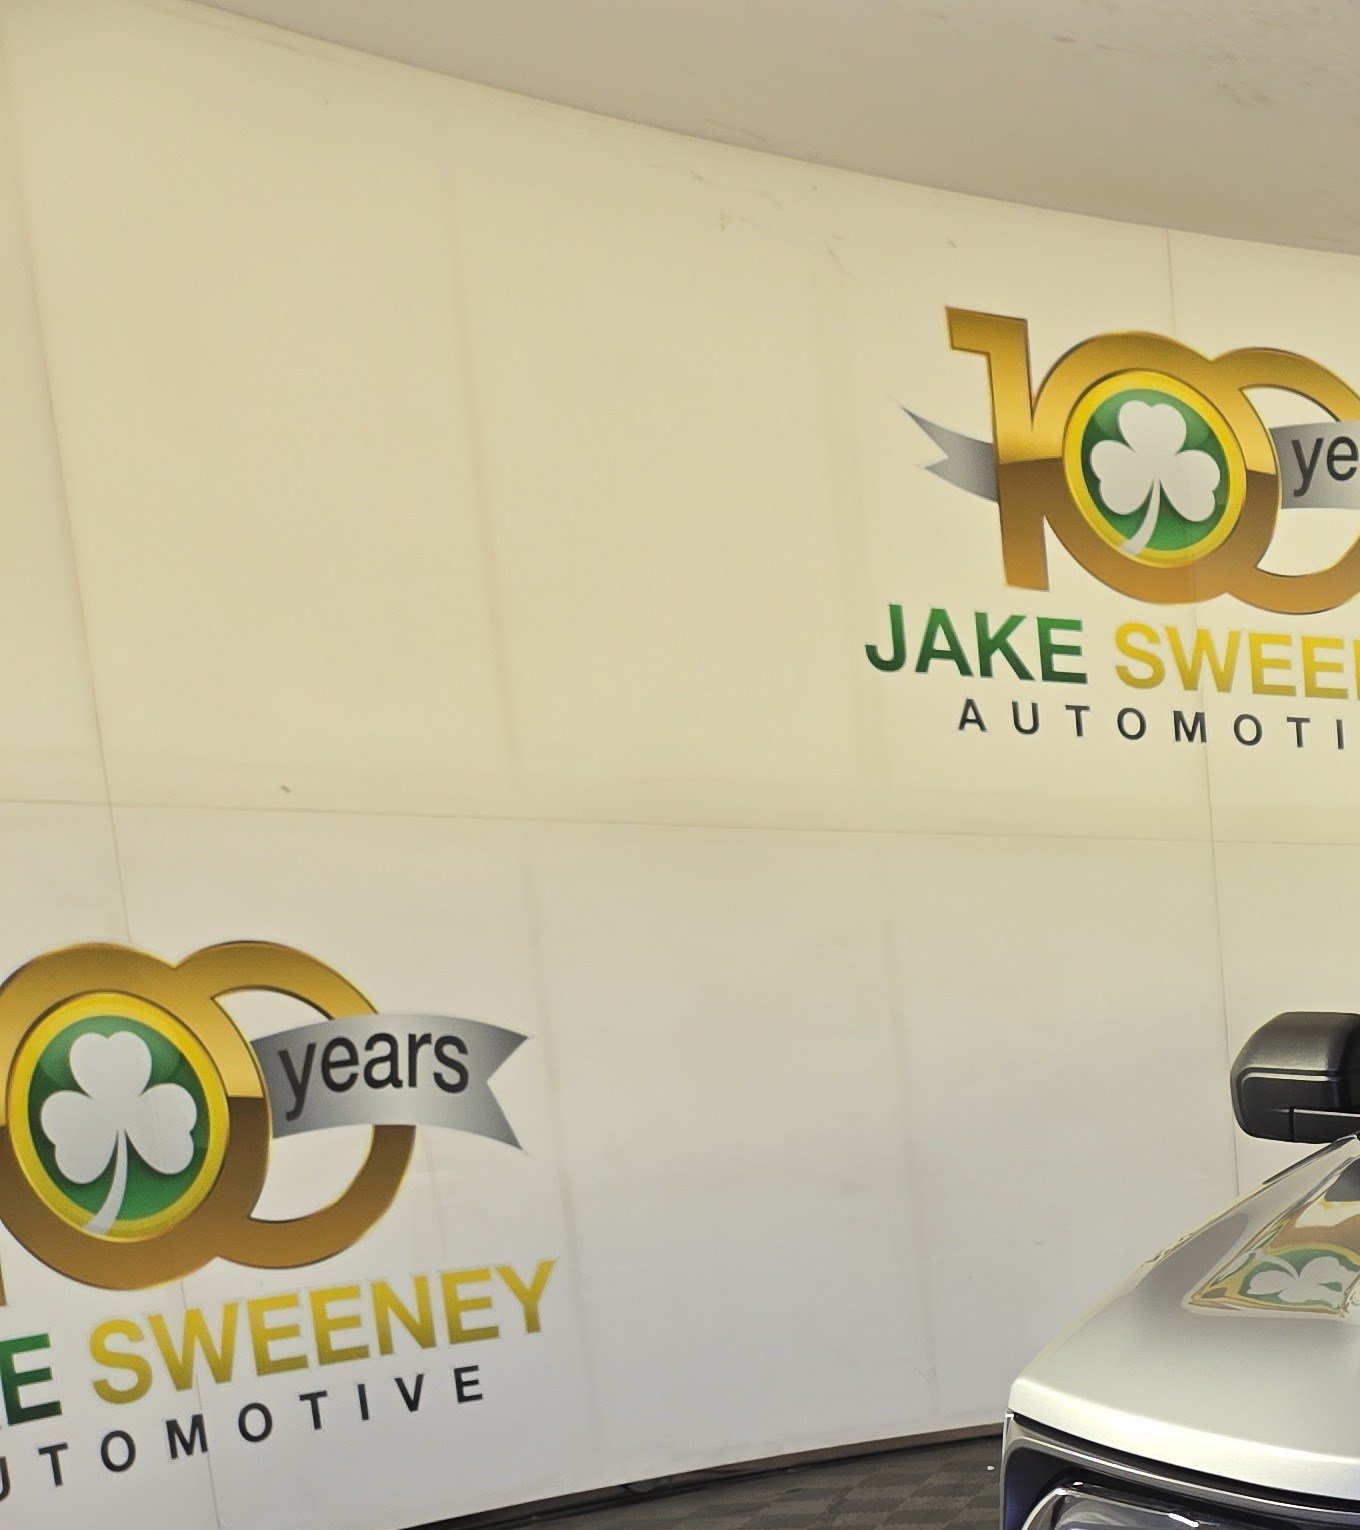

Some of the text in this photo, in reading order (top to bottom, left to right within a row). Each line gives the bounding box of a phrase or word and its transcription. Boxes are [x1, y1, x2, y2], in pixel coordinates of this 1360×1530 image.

[865, 603, 1088, 686] JAKE
[278, 1031, 469, 1121] years
[88, 1259, 557, 1404] SWEENEY
